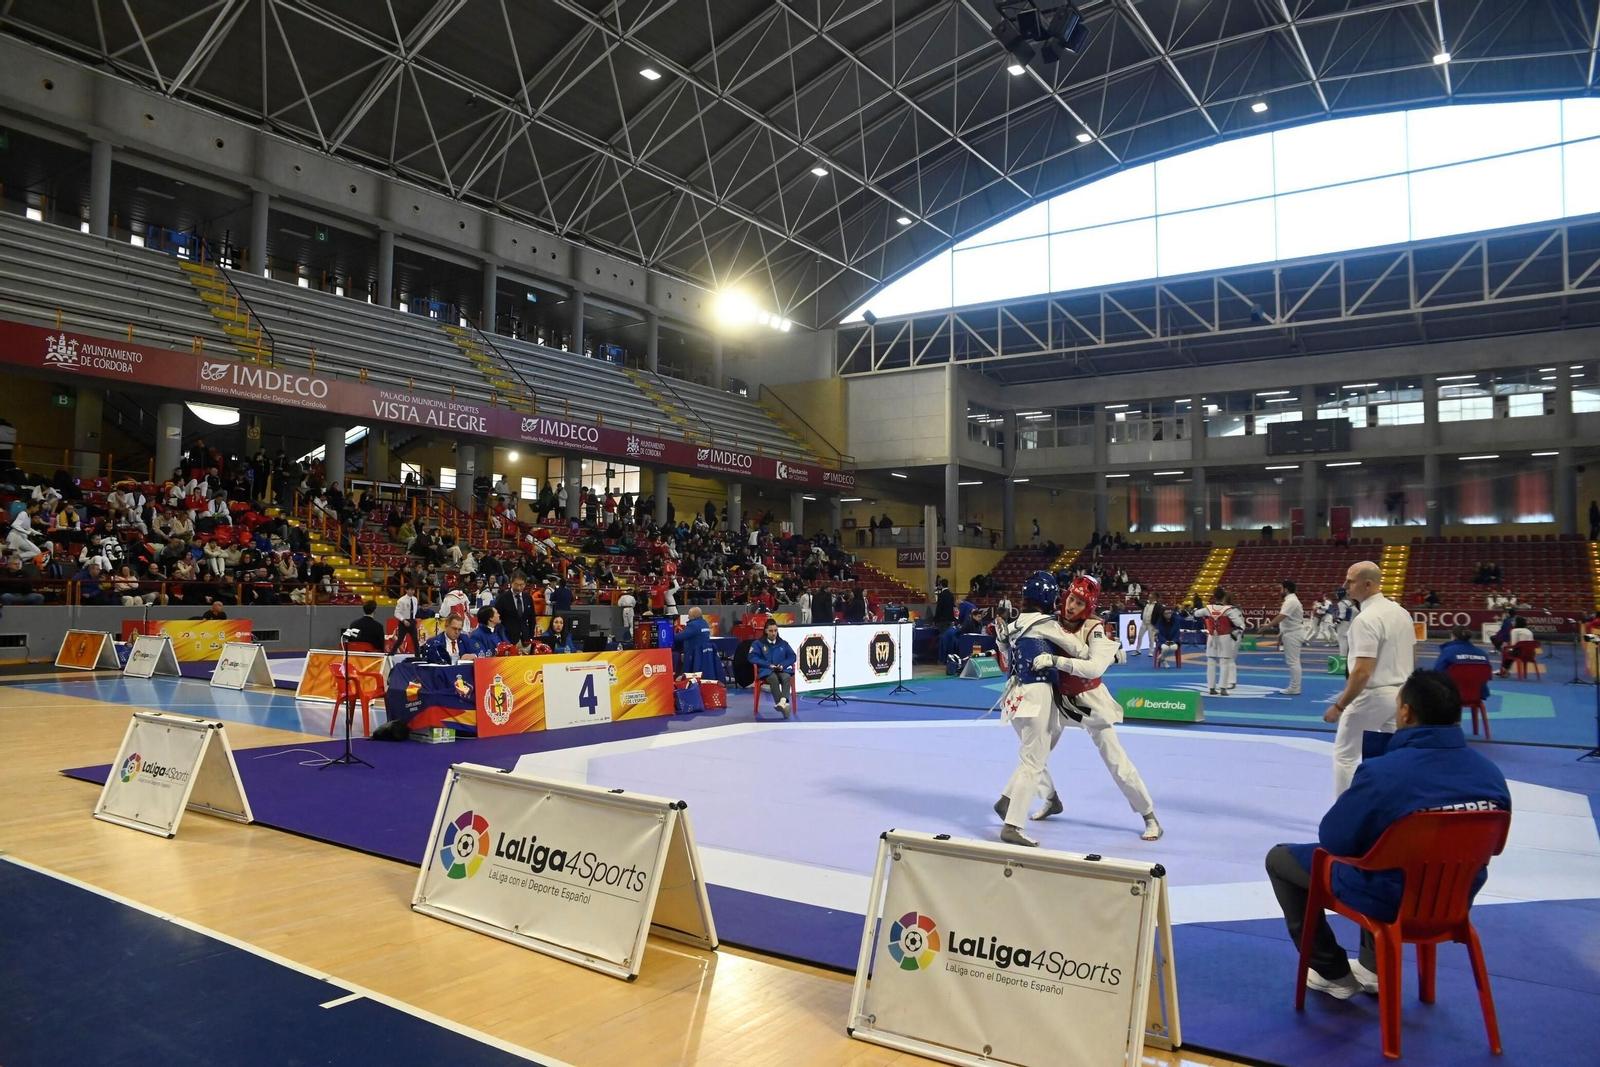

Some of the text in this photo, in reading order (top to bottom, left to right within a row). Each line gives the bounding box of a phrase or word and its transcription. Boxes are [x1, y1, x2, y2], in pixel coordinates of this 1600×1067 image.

[319, 232, 325, 241] 3
[81, 344, 143, 363] AYUNTAMIENTO
[81, 356, 92, 367] DE
[233, 365, 328, 398] IMDECO
[59, 394, 68, 405] B
[201, 384, 229, 394] Instituto
[230, 388, 262, 399] Municipal
[263, 393, 271, 401] de
[272, 395, 300, 406] Deportes
[380, 391, 480, 414] PALACIO MUNICIPAL DEPORTES
[372, 400, 488, 433] VISTA ALEGRE
[540, 419, 599, 443] IMDECO
[640, 440, 666, 451] AYUNTAMIENTO
[710, 449, 752, 468] IMDECO
[830, 472, 855, 485] IMDECO
[642, 630, 647, 640] 2
[661, 629, 666, 639] 0
[579, 674, 598, 715] 4
[1144, 700, 1186, 710] Iberdrola
[142, 761, 189, 782] LaLiga4Sports
[495, 832, 647, 892] LaLiga4Sports
[488, 869, 592, 905] LaLiga con el Deporte Español
[948, 931, 1122, 986] LaLiga4Sports
[945, 962, 1064, 996] LaLiga con el Deporte Español
